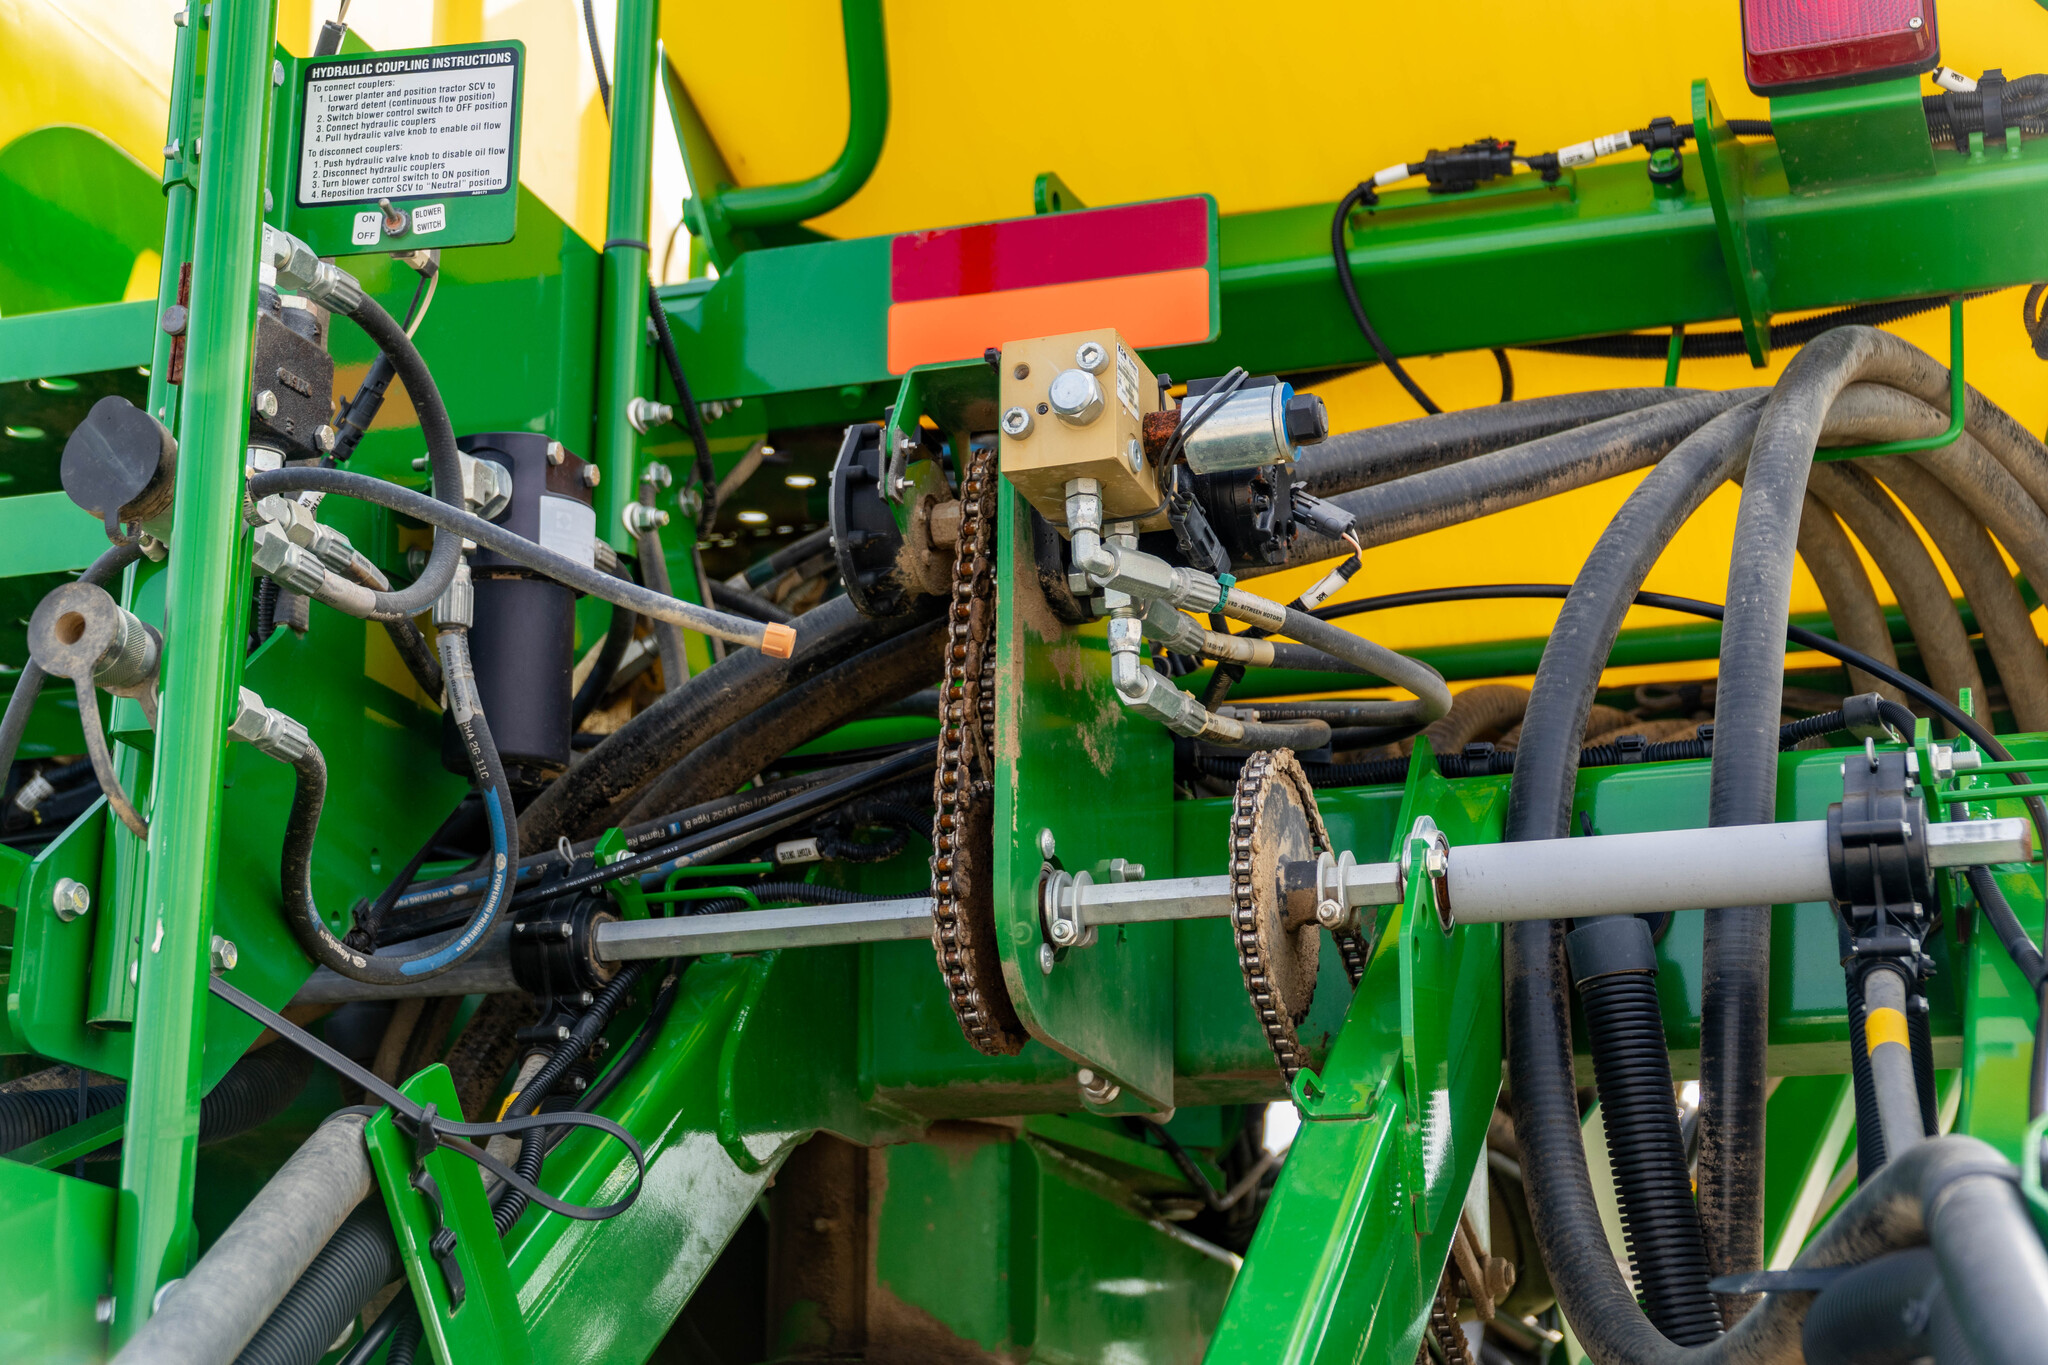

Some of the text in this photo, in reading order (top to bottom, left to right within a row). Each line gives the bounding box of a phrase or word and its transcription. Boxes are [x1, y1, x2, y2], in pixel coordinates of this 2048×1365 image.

[312, 52, 511, 78] HYDRAULIC COUPLING INSTRUCTIONS
[325, 82, 355, 92] connect
[358, 80, 395, 90] couplers:
[329, 94, 352, 102] Lower
[356, 91, 384, 101] planter
[404, 86, 436, 97] position
[440, 84, 466, 93] tractor
[469, 82, 485, 91] SCV
[328, 102, 358, 112] forward
[362, 100, 386, 109] detent
[389, 96, 436, 108] (continuous
[459, 92, 495, 102] position)
[327, 114, 353, 122] Switch
[357, 111, 384, 120] blower
[386, 107, 414, 118] control
[417, 106, 443, 115] switch
[456, 103, 472, 112] OFF
[475, 102, 507, 112] position
[327, 123, 358, 132] Connect
[361, 120, 398, 130] hydraulic
[401, 117, 436, 126] couplers
[326, 134, 341, 142] Pull
[344, 131, 381, 142] hydraulic
[384, 129, 405, 137] valve
[441, 124, 467, 133] enable
[320, 146, 362, 156] disconnect
[366, 144, 402, 153] couplers:
[346, 156, 383, 167] hydraulic
[443, 150, 472, 158] disable
[323, 168, 367, 178] Disconnect
[370, 164, 407, 175] hydraulic
[410, 162, 445, 171] couplers
[372, 175, 400, 184] control
[403, 172, 428, 181] switch
[457, 169, 489, 179] position
[322, 188, 364, 198] Reposition
[368, 186, 394, 195] tractor
[396, 184, 413, 192] SCV
[427, 180, 466, 189] "Neutral"
[469, 178, 502, 188] position
[416, 207, 441, 218] BLOWER
[417, 220, 441, 231] SWITCH
[1241, 604, 1262, 615] BETWEEN
[1263, 611, 1282, 622] MOTORS
[448, 668, 462, 712] Hydraulics
[470, 740, 489, 779] 2G-11C
[692, 814, 710, 825] Type
[712, 805, 738, 820] 18752
[640, 828, 665, 842] Flame
[780, 850, 795, 860] DRIVE
[542, 886, 557, 896] PACE
[566, 872, 604, 887] PNEUMATICS
[410, 890, 448, 904] POWERING
[486, 873, 503, 913] POWERING
